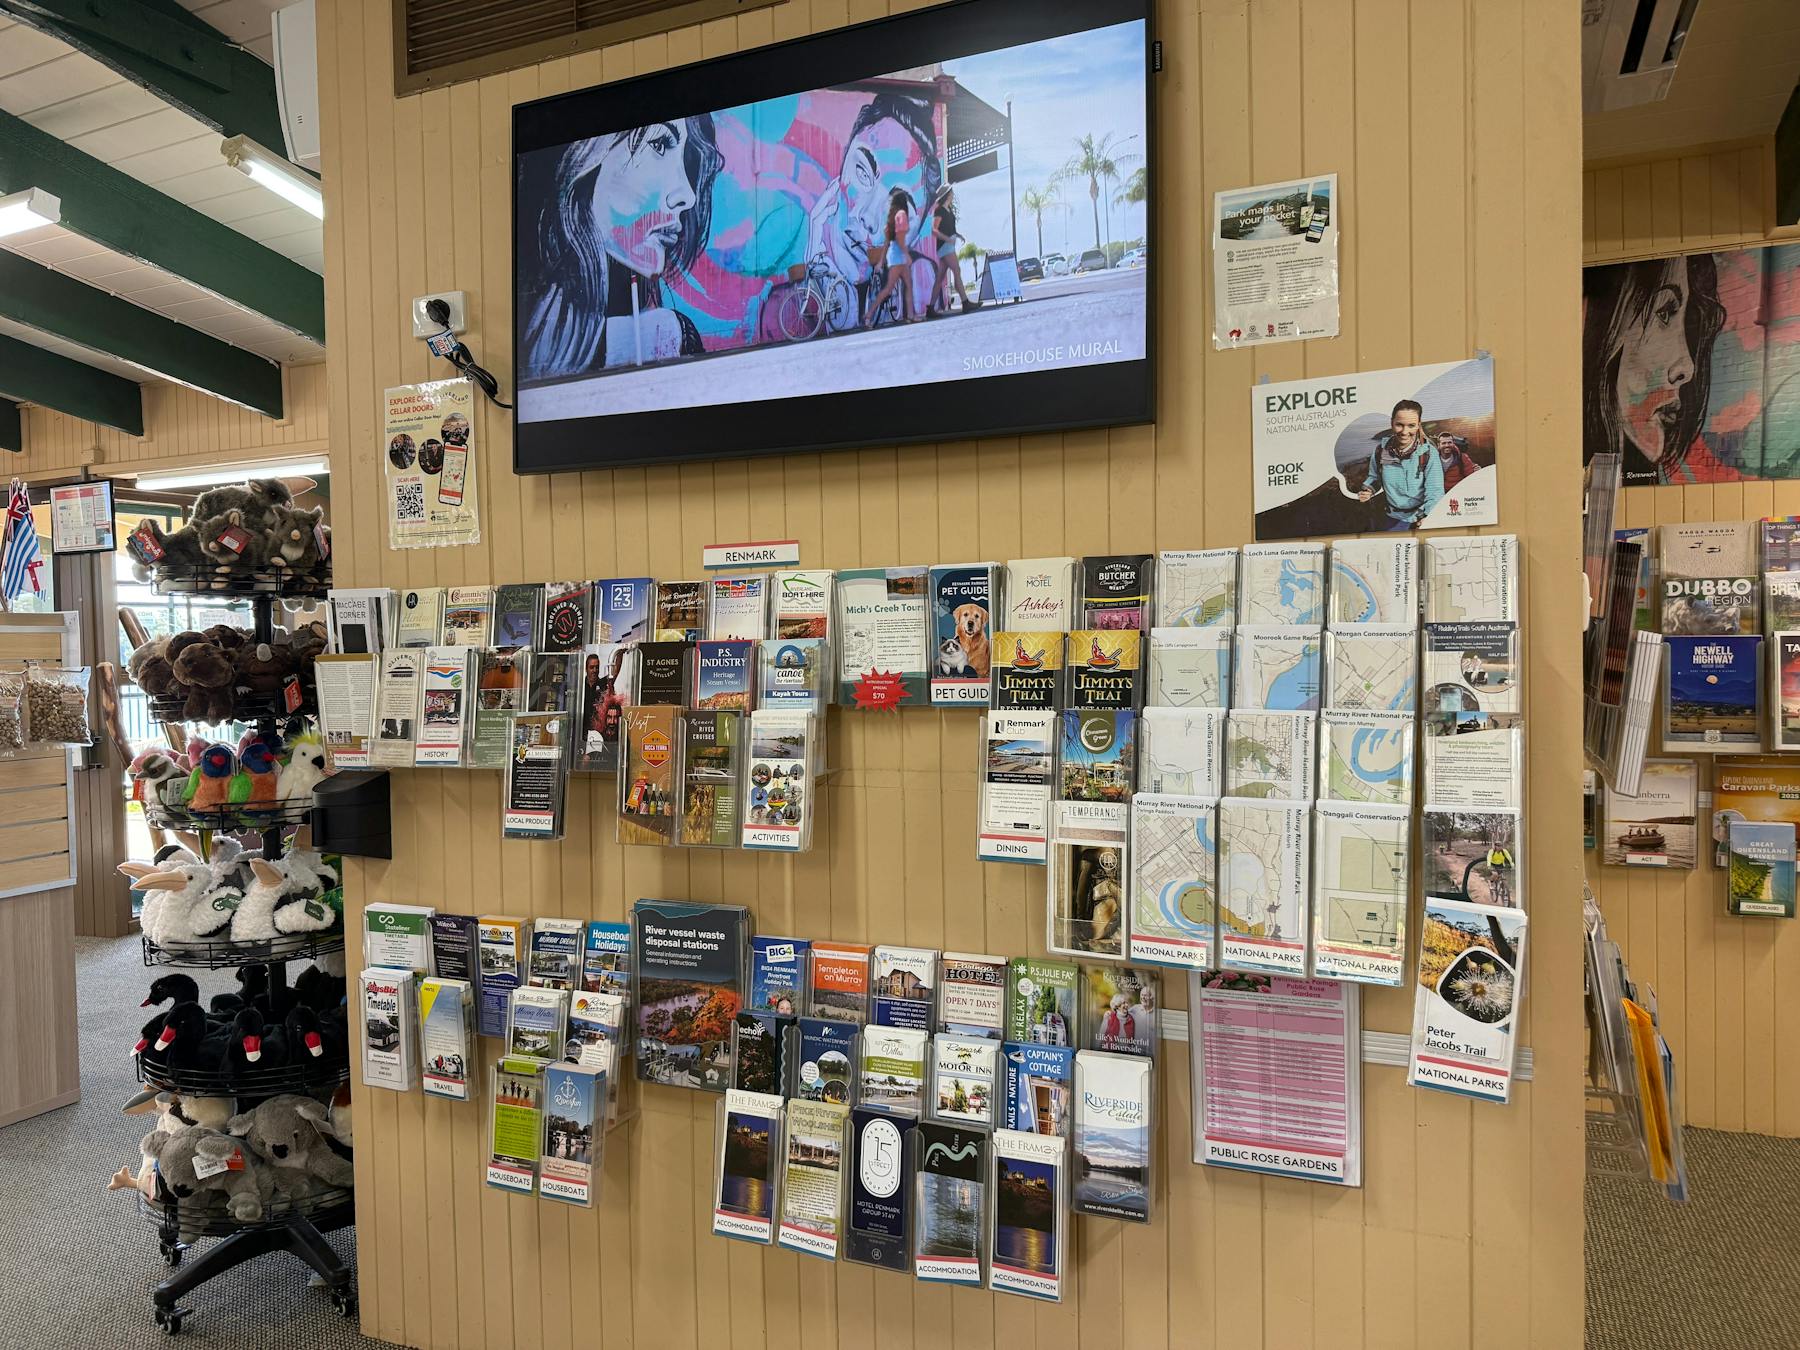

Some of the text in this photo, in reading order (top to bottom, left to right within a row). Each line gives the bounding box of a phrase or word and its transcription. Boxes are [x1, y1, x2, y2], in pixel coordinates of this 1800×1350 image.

[1225, 203, 1286, 217] Park maps in
[1239, 211, 1296, 228] your pocket
[963, 339, 1123, 371] SMOKEHOUSE MURAL
[1265, 386, 1357, 413] EXPLORE
[389, 404, 434, 416] CELLAR DOORS
[1265, 409, 1347, 426] SOUTH AUSTRALIA'S
[1265, 420, 1335, 435] NATIONAL PARKS
[1268, 462, 1304, 476] BOOK
[1268, 474, 1299, 487] HERE
[725, 549, 776, 562] RENMARK
[1163, 550, 1227, 560] Murray River National
[1098, 571, 1136, 581] BUTCHER
[1026, 580, 1052, 588] MOTEL
[1665, 579, 1752, 597] DUBBO
[942, 586, 989, 596] PET GUIDE
[1394, 584, 1402, 598] Park
[1012, 596, 1064, 612] Ashley's
[1704, 595, 1751, 606] REGION
[339, 611, 366, 619] CORNER
[846, 605, 872, 614] Mick's
[875, 604, 900, 613] Creek
[1018, 612, 1058, 620] RESTAURANT
[1335, 630, 1362, 638] Morgan
[718, 648, 733, 657] P.S.
[1694, 646, 1733, 655] NEWELL
[656, 658, 679, 666] AGNES
[701, 657, 746, 667] INDUSTRY
[1692, 654, 1734, 665] HIGHWAY
[713, 671, 736, 679] Heritage
[777, 669, 803, 678] canoe
[999, 674, 1056, 690] JIMMY'S
[1074, 673, 1133, 690] JIMMY'S
[772, 690, 791, 698] Kayak
[872, 692, 886, 700] $70
[935, 688, 956, 699] PET
[1009, 689, 1045, 704] THAI
[1084, 689, 1122, 704] THAI
[1325, 711, 1399, 720] Murray River National
[1007, 719, 1046, 728] Renmark
[1007, 727, 1026, 735] Club
[424, 750, 449, 758] HISTORY
[1722, 783, 1800, 792] Caravan Parks
[1136, 799, 1206, 810] Murray River National
[1068, 806, 1121, 818] TEMPERANCE
[1323, 810, 1401, 822] Danggali Conservation
[506, 817, 552, 825] LOCAL PRODUCE
[752, 832, 791, 842] ACTIVITIES
[996, 843, 1028, 855] DINING
[480, 928, 513, 940] RENMARK
[645, 924, 726, 941] River vessel waste
[594, 939, 626, 953] Holidays
[645, 935, 719, 951] disposal stations
[645, 949, 664, 957] General
[664, 951, 691, 960] information
[768, 947, 793, 957] BIG4
[1133, 945, 1204, 962] NATIONAL PARKS
[1225, 946, 1301, 963] NATIONAL PARKS
[645, 956, 698, 967] operating instructions
[1318, 955, 1399, 975] NATIONAL PARKS
[773, 966, 798, 974] RENMARK
[818, 964, 859, 976] Templeton
[945, 968, 1003, 983] HOTEL
[1061, 970, 1075, 980] FAY
[835, 975, 863, 987] Murray
[367, 997, 396, 1012] Timetable
[945, 996, 968, 1006] OPEN
[969, 998, 975, 1006] 7
[1015, 999, 1025, 1032] RELAX
[739, 1027, 758, 1036] echo
[1426, 1024, 1456, 1041] Peter
[1095, 1032, 1150, 1047] Life's Wonderful
[946, 1042, 983, 1055] Renmark
[1101, 1042, 1142, 1055] at Riverside
[1425, 1036, 1487, 1058] Jacobs Trail
[1027, 1049, 1064, 1063] CAPTAIN'S
[939, 1061, 993, 1075] MOTOR INN
[1028, 1061, 1062, 1075] COTTAGE
[1008, 1067, 1017, 1099] NATURE
[1417, 1066, 1505, 1093] NATIONAL PARKS
[433, 1082, 454, 1092] TRAVEL
[730, 1094, 746, 1105] THE
[1084, 1092, 1143, 1112] RIVERSIDE
[998, 1137, 1017, 1151] THE
[1210, 1146, 1337, 1172] PUBLIC ROSE GARDENS
[489, 1170, 531, 1187] HOUSEBOATS
[542, 1181, 585, 1197] HOUSEBOATS
[716, 1218, 768, 1234] ACCOMMODATION
[781, 1231, 835, 1251] ACCOMMODATION
[918, 1265, 977, 1276] ACCOMMODATION
[993, 1272, 1057, 1291] ACCOMMODATION
